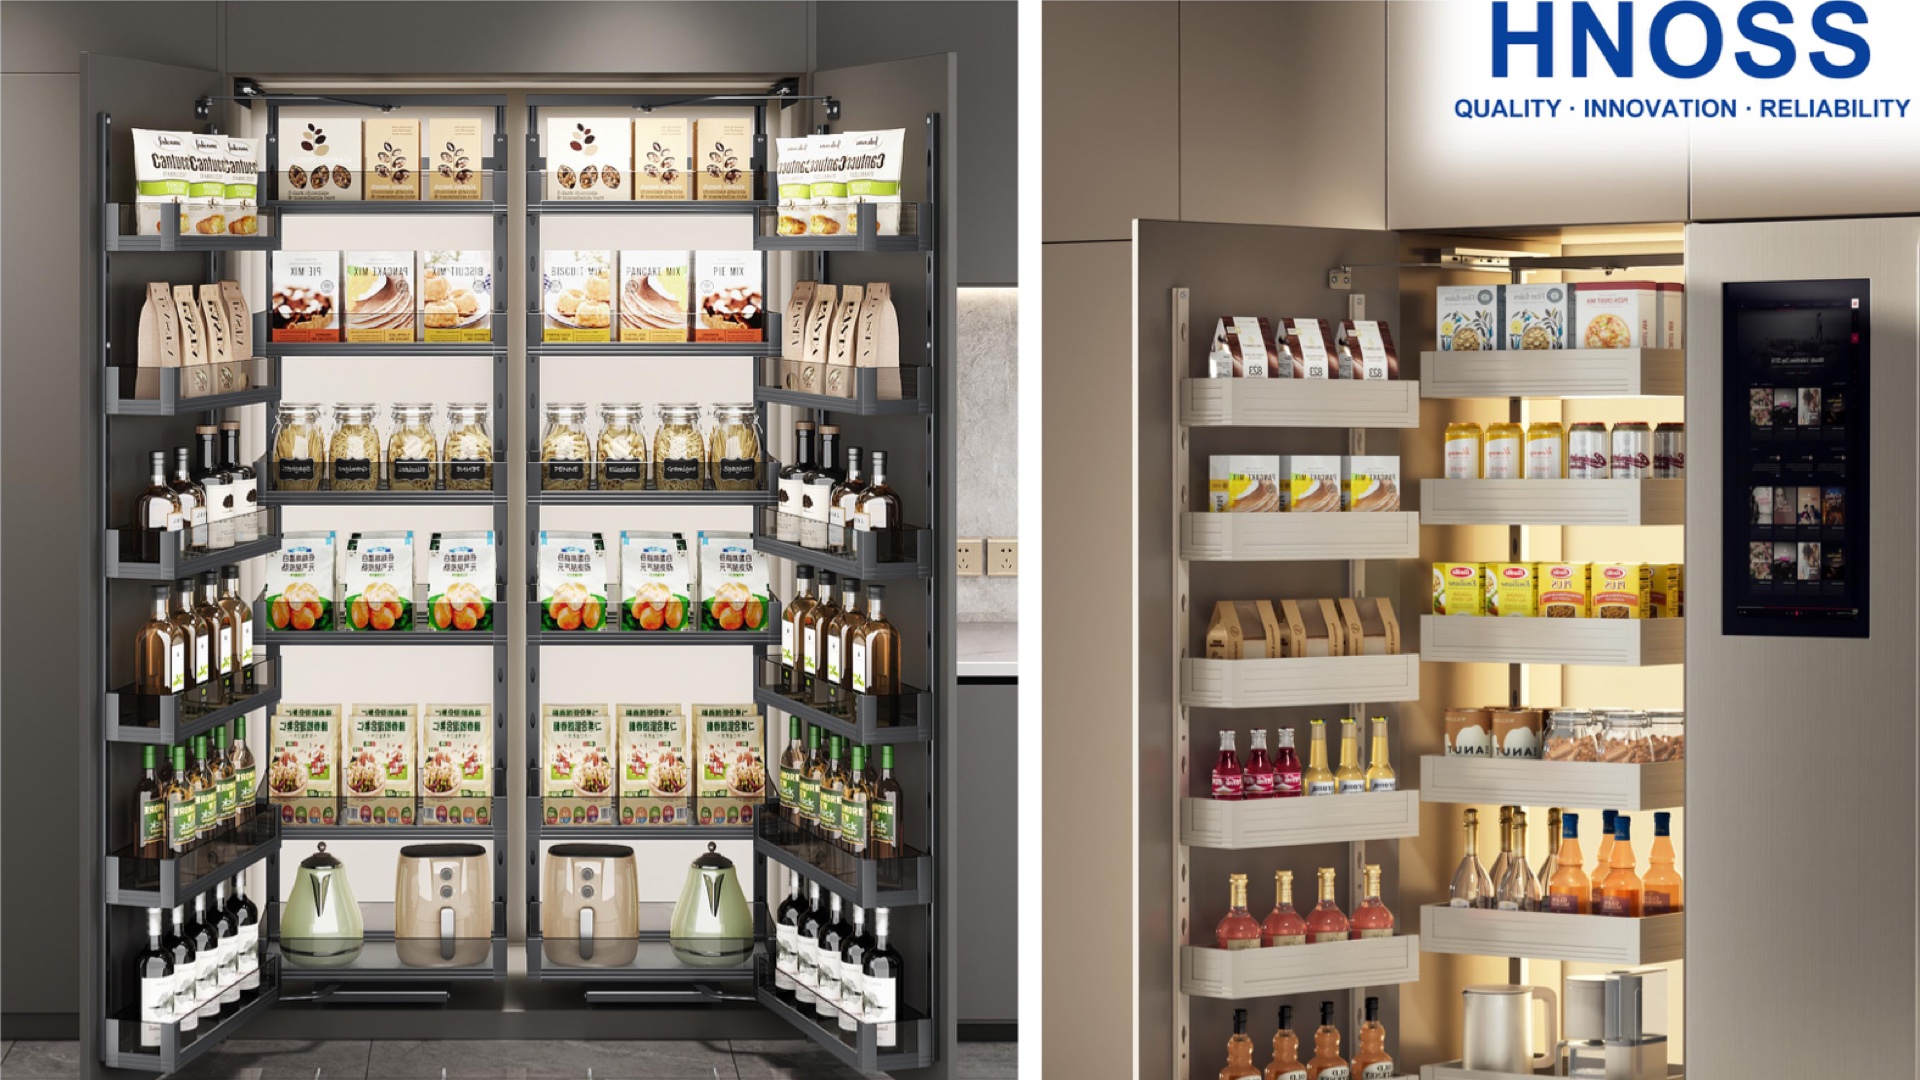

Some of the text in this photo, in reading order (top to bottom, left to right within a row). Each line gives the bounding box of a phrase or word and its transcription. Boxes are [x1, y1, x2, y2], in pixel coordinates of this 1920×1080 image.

[551, 266, 603, 276] BISCUIT MIX
[626, 266, 681, 276] PANCAKE MIX
[714, 266, 744, 276] PIE MIX
